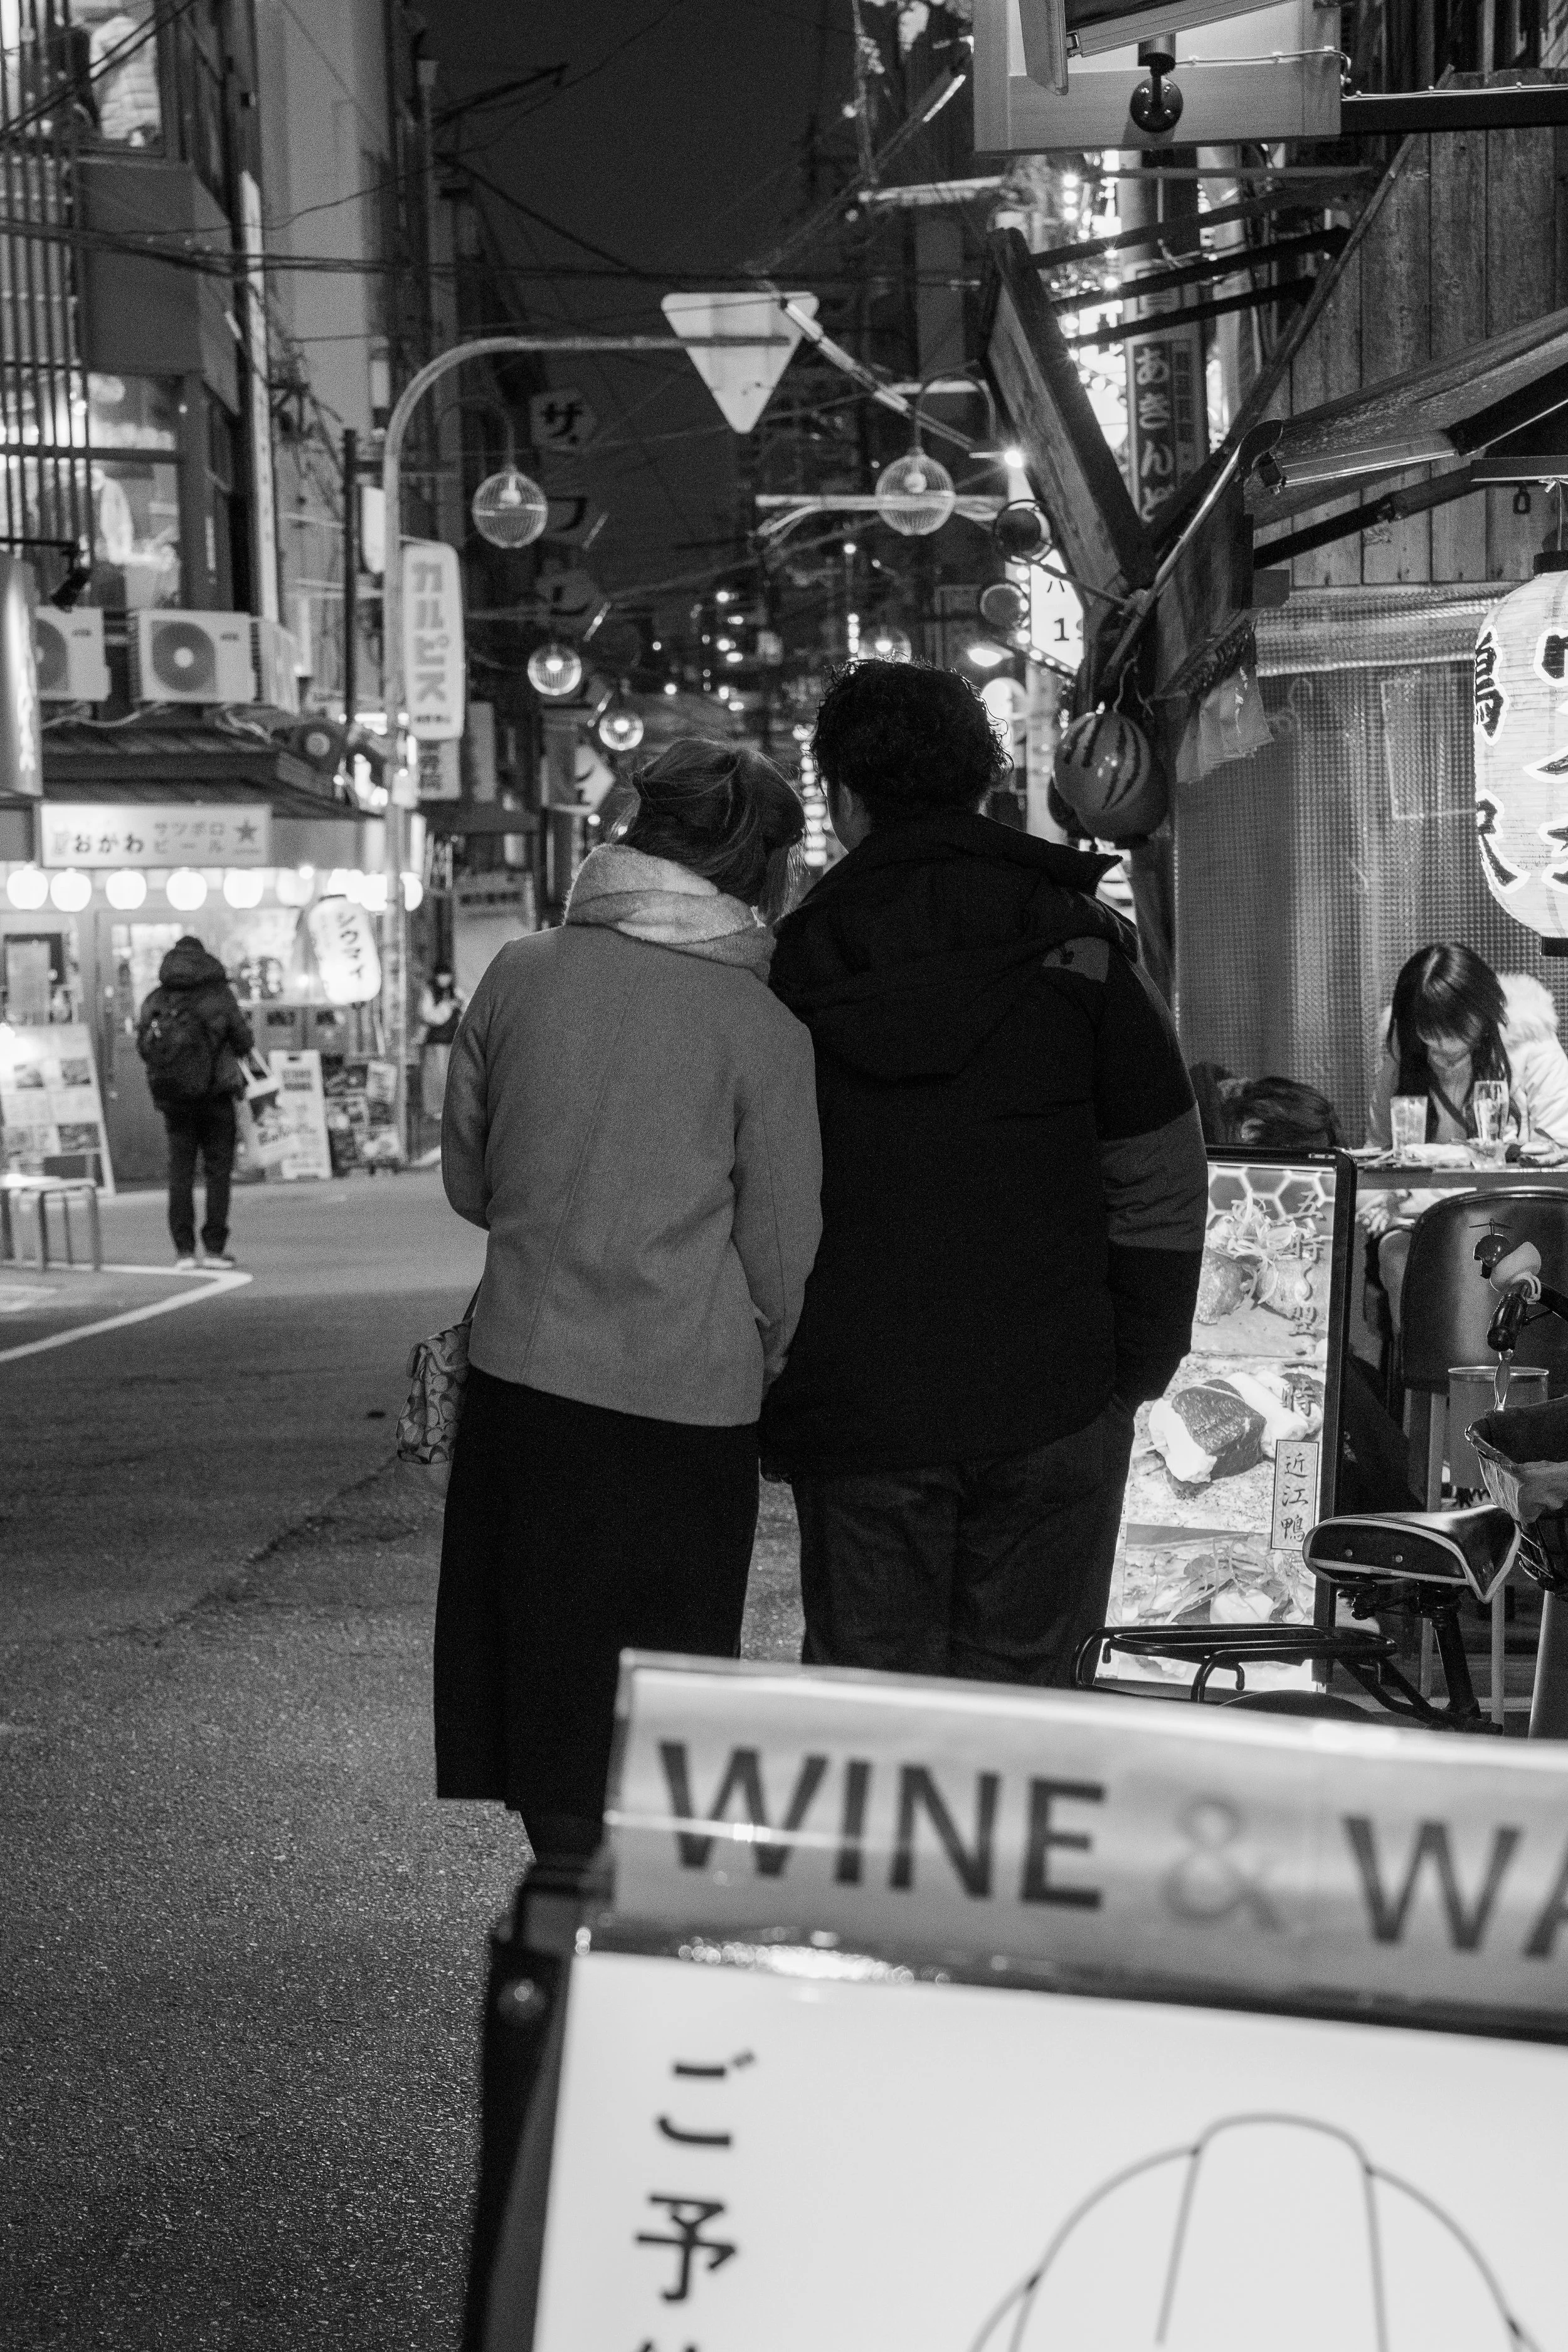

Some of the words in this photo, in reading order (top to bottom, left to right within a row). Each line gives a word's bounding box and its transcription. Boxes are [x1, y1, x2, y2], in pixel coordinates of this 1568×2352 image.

[1281, 1453, 1308, 1542] 近江鴨
[659, 1739, 1106, 1910] WINE
[1163, 1795, 1283, 1929] &
[635, 2048, 755, 2352] ご予
